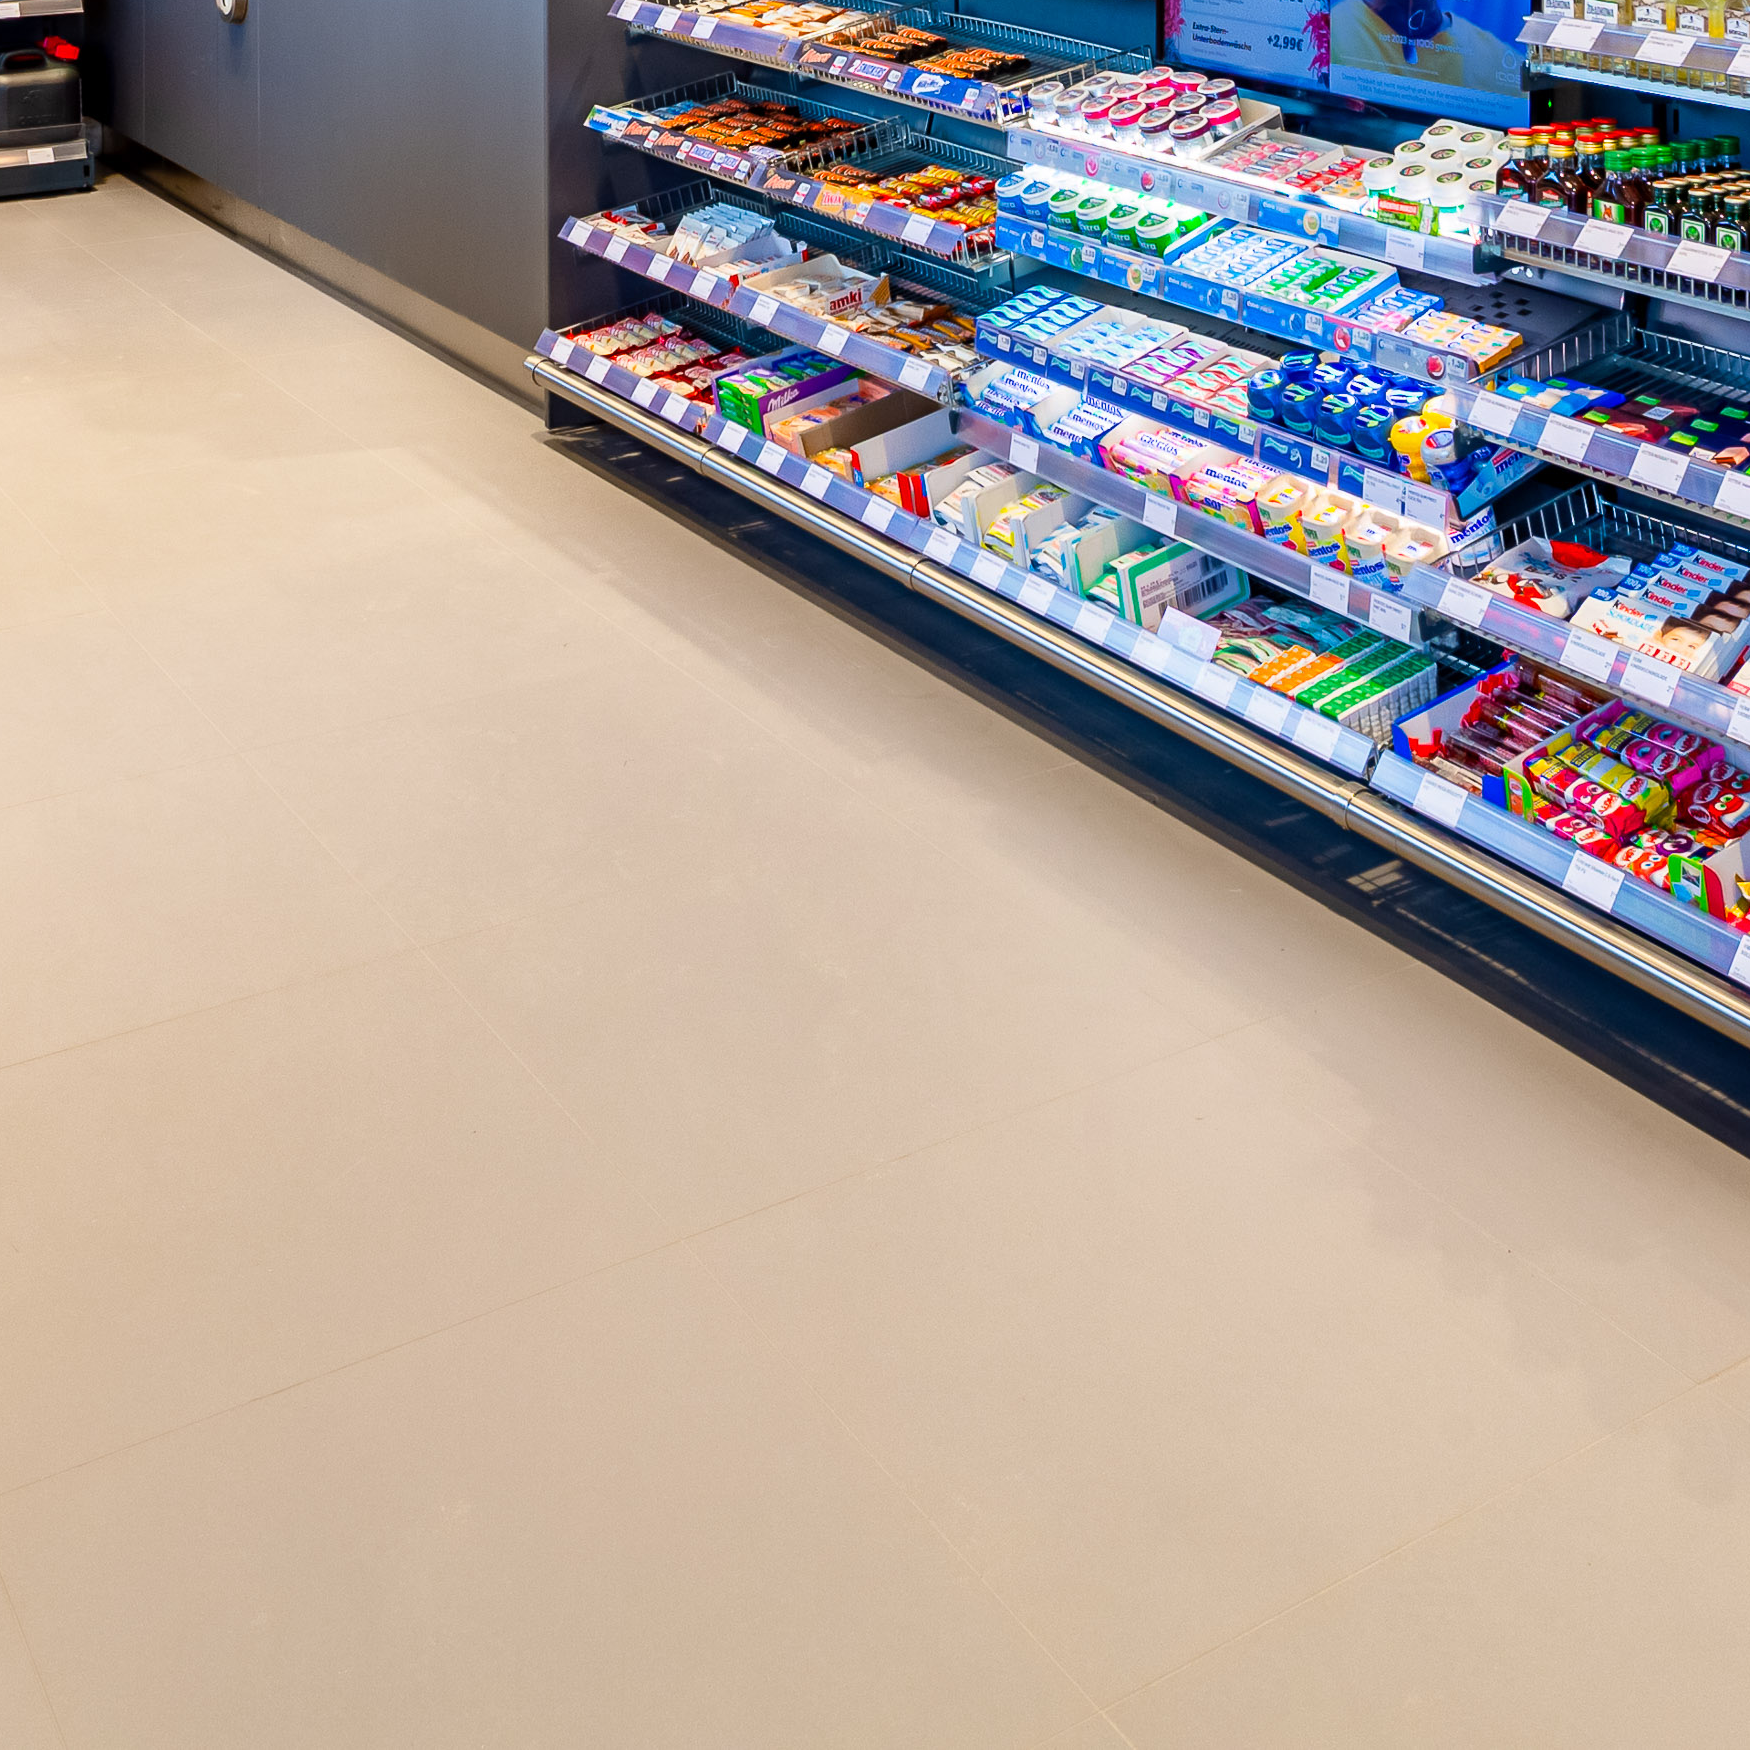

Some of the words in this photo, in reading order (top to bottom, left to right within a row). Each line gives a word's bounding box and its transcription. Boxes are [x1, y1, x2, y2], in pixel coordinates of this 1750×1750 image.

[1267, 35, 1303, 51] +2,99€
[1016, 370, 1050, 389] mentos
[767, 389, 799, 412] Milka
[1206, 467, 1248, 489] mentos
